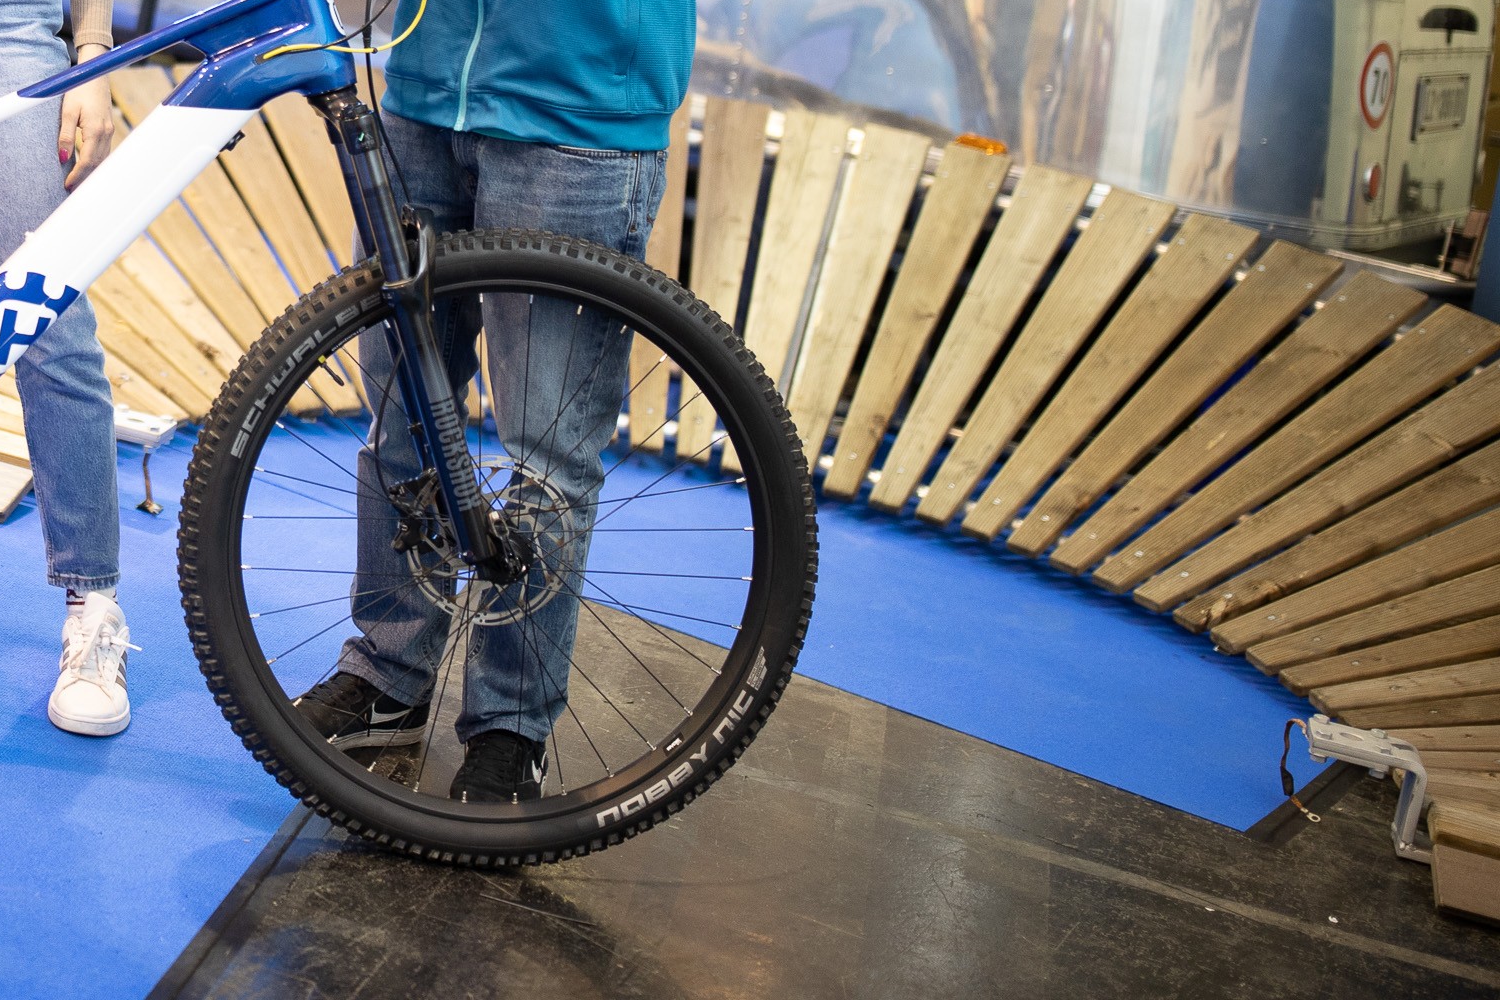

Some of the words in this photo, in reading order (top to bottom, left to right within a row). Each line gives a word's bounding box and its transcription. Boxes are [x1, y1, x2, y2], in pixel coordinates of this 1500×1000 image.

[1371, 68, 1390, 107] 70
[230, 293, 385, 460] SCHWALBE
[429, 399, 483, 512] ROCKSHOX
[596, 741, 709, 829] NOBBY
[712, 688, 755, 745] NIC
